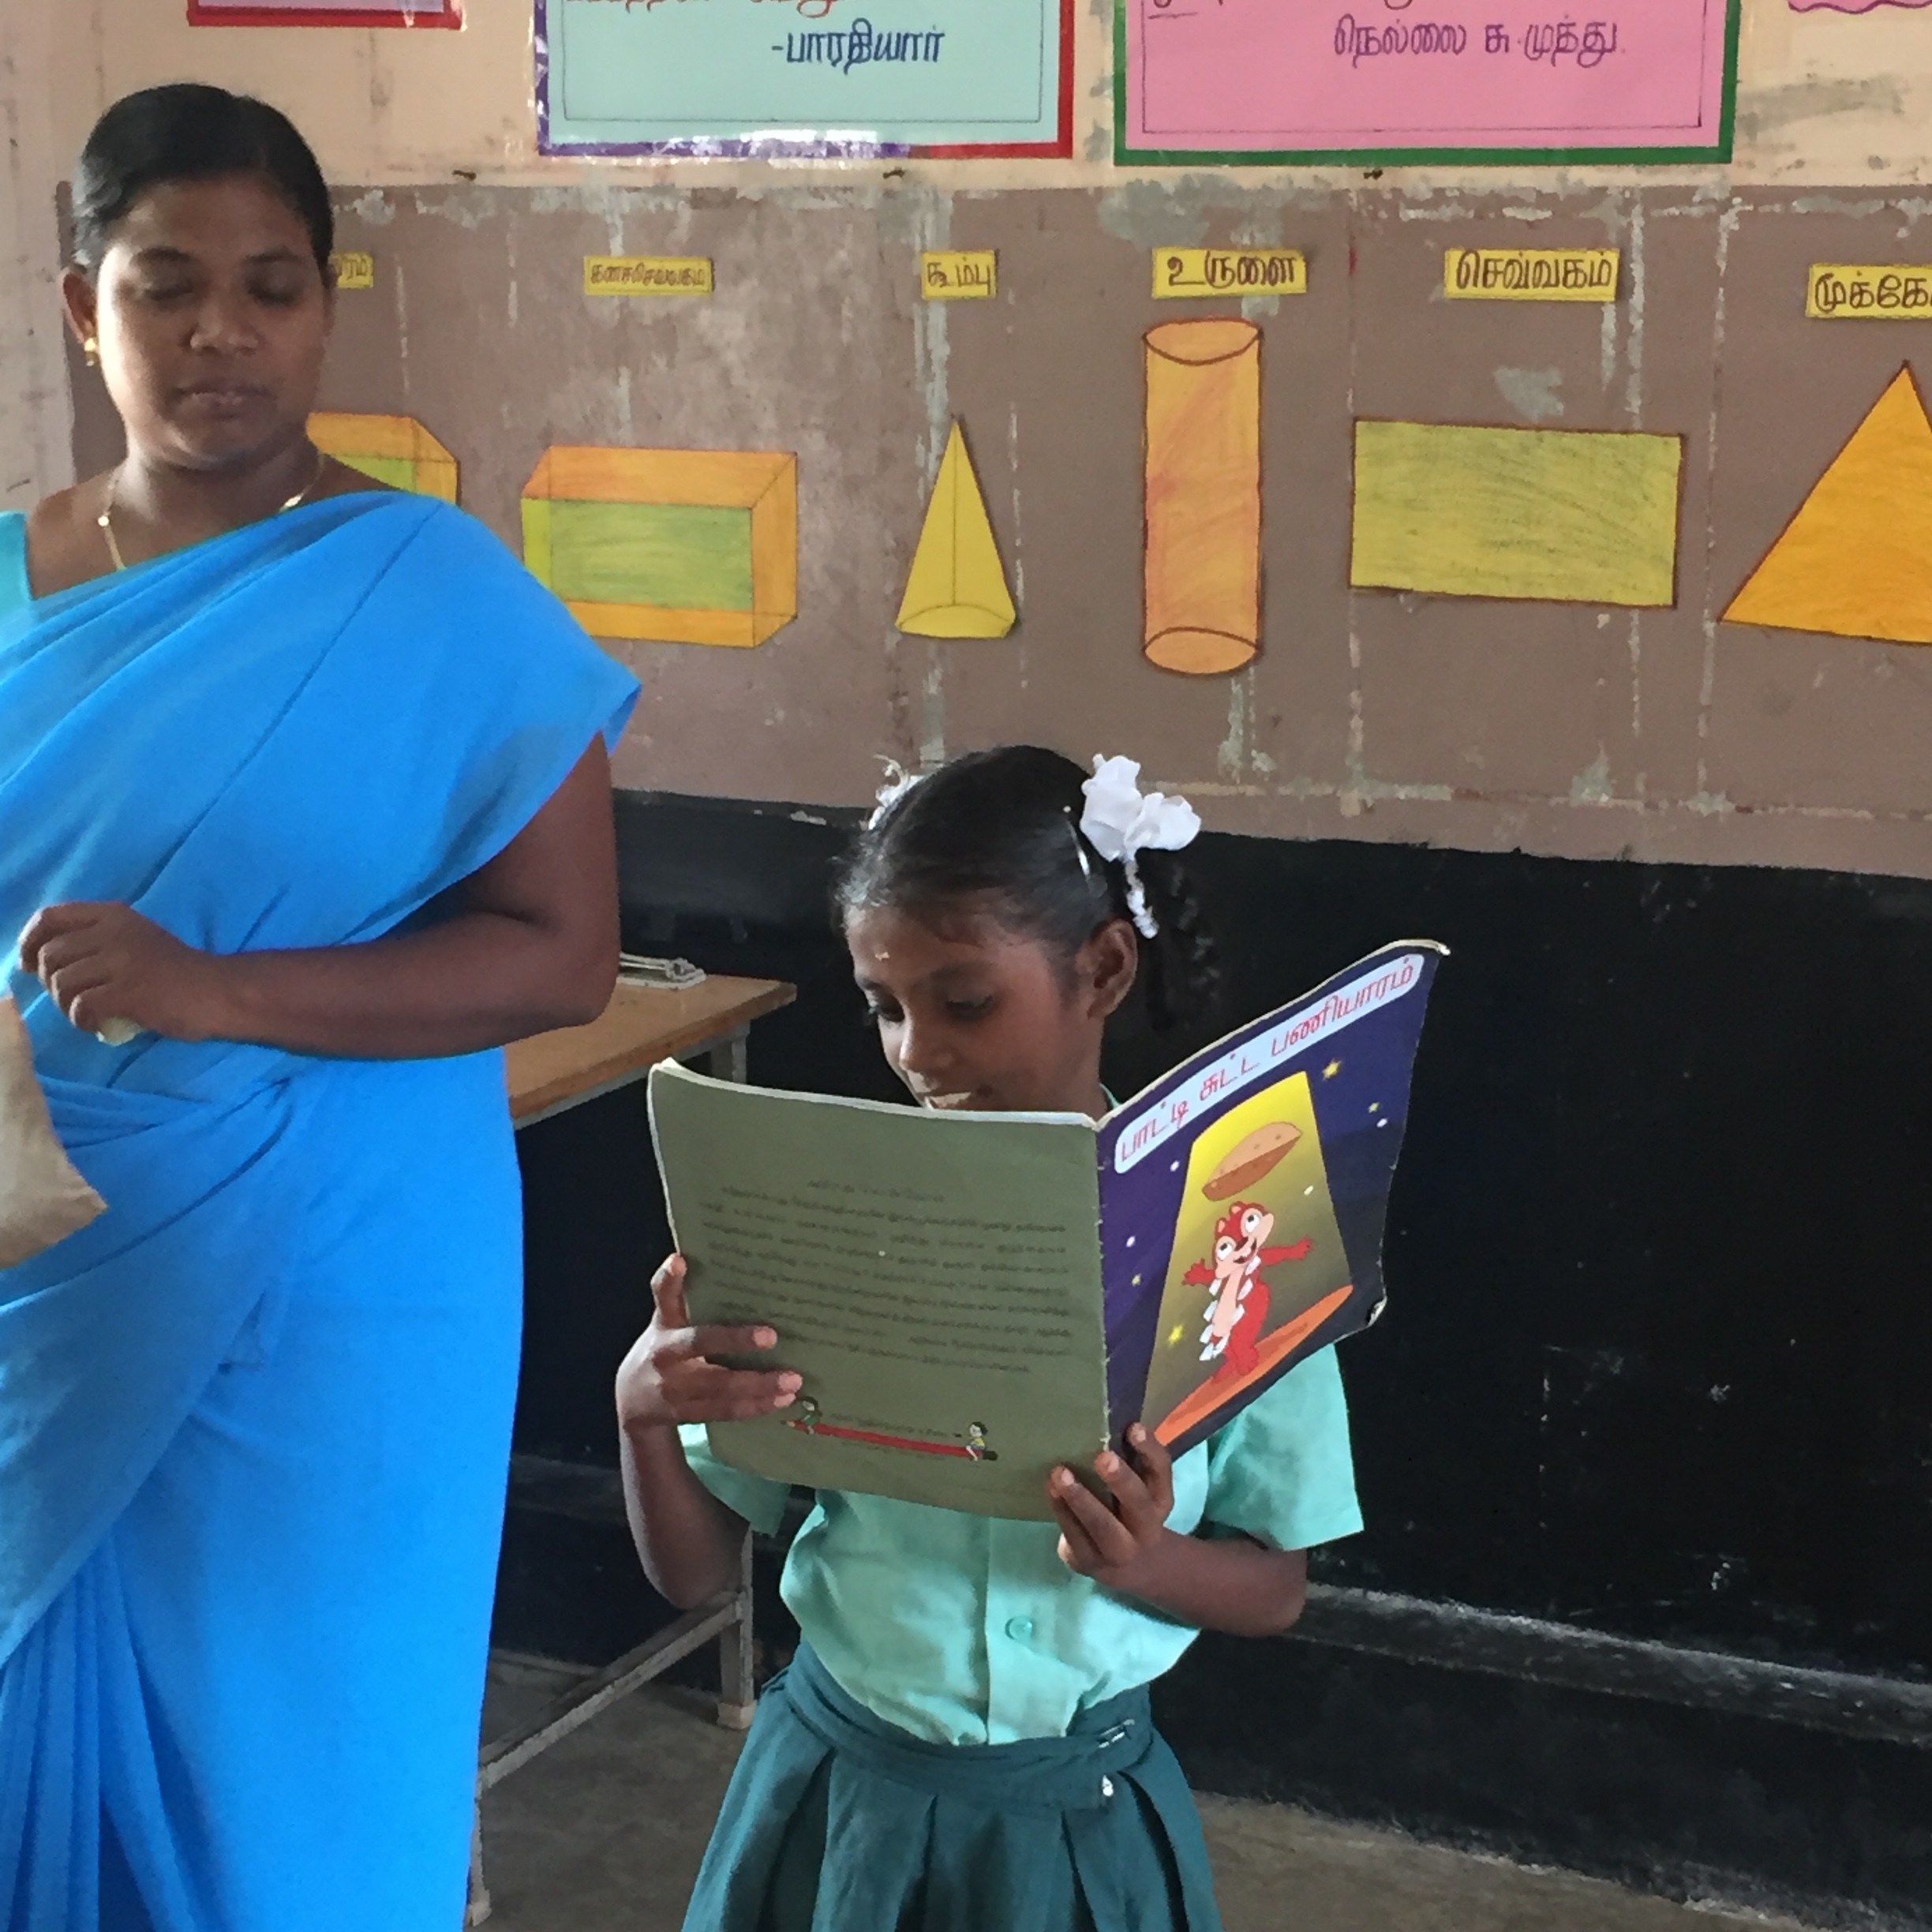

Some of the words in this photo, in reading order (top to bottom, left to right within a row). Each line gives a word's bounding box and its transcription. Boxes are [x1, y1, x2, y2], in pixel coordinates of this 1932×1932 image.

[771, 17, 945, 76] -பாரதியார்
[1334, 13, 1468, 69] நெல்லை
[927, 256, 990, 295] கூம்பு
[1166, 250, 1297, 290] உருளை
[1456, 249, 1612, 290] செவ்வகம்
[1121, 1099, 1189, 1163] பாட்டி
[1199, 1053, 1261, 1102] சுட்ட
[1270, 957, 1414, 1058] பணியாரம்
